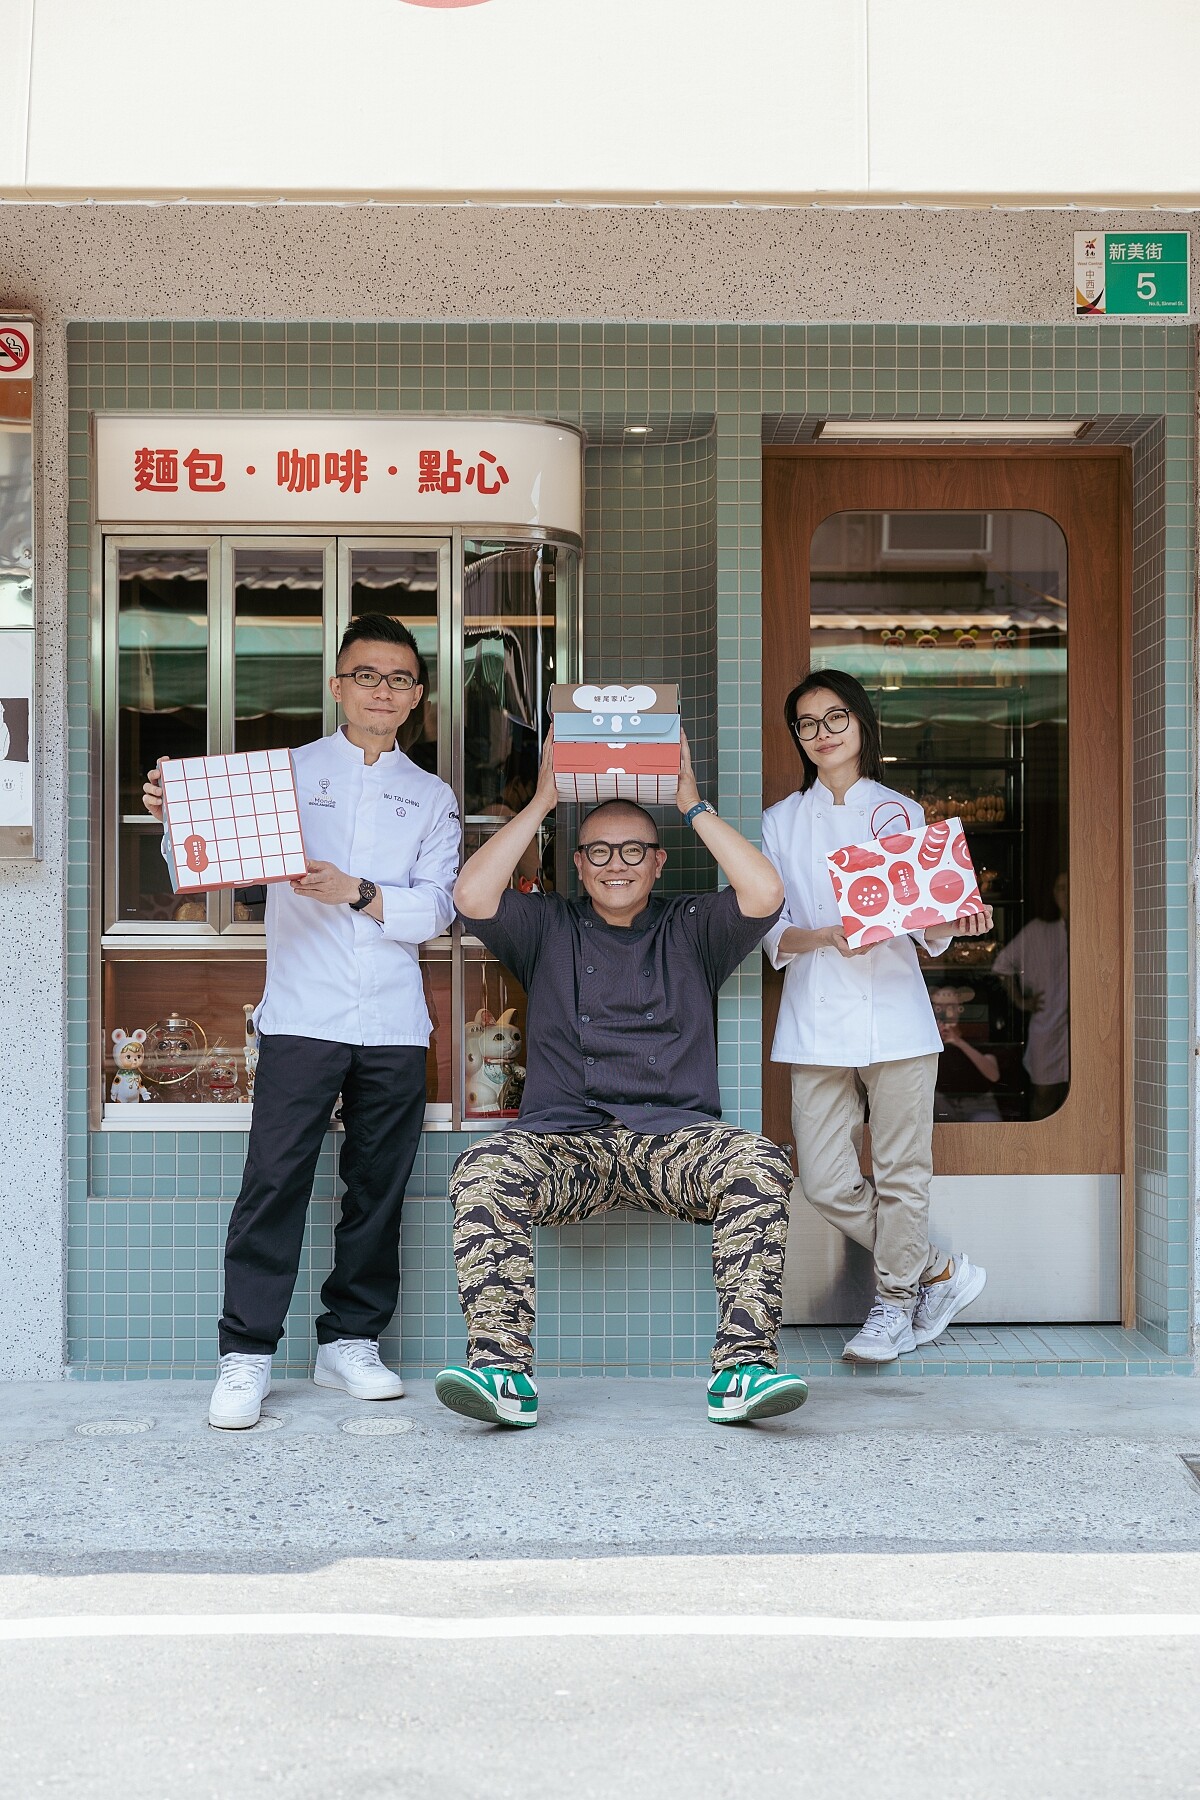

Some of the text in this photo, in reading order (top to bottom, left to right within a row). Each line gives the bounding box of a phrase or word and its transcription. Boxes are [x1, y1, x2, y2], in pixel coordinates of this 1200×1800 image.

[1109, 243, 1163, 260] 新美街
[1085, 270, 1095, 298] 中西區
[1136, 272, 1157, 300] 5
